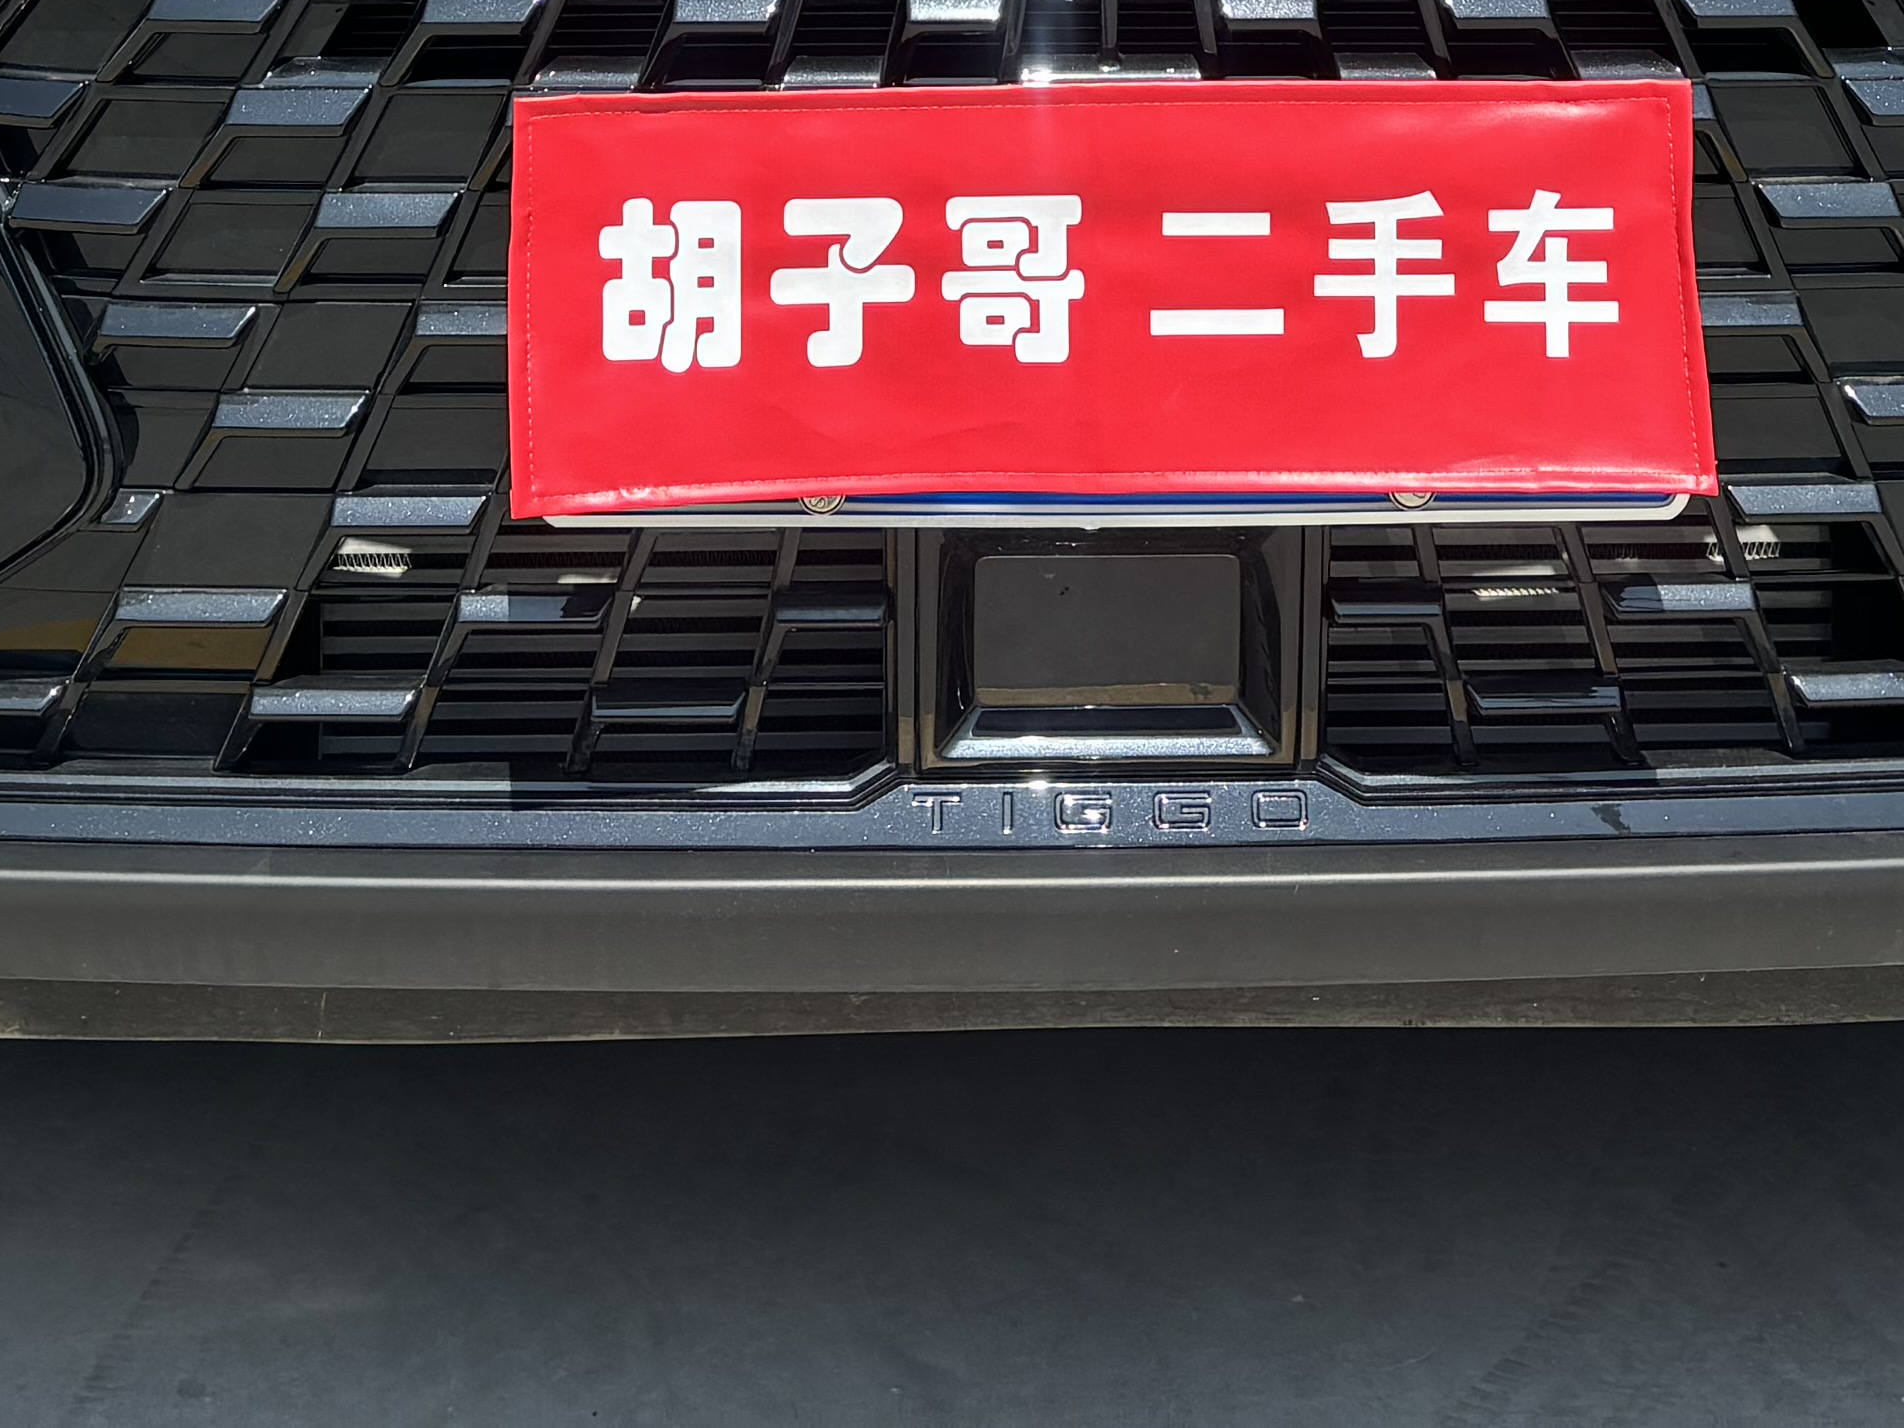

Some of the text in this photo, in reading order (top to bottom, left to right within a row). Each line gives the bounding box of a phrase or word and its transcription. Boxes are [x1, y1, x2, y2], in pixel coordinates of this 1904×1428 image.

[598, 188, 1621, 374] 胡子哥 二手车
[911, 789, 1310, 836] TIGGO
